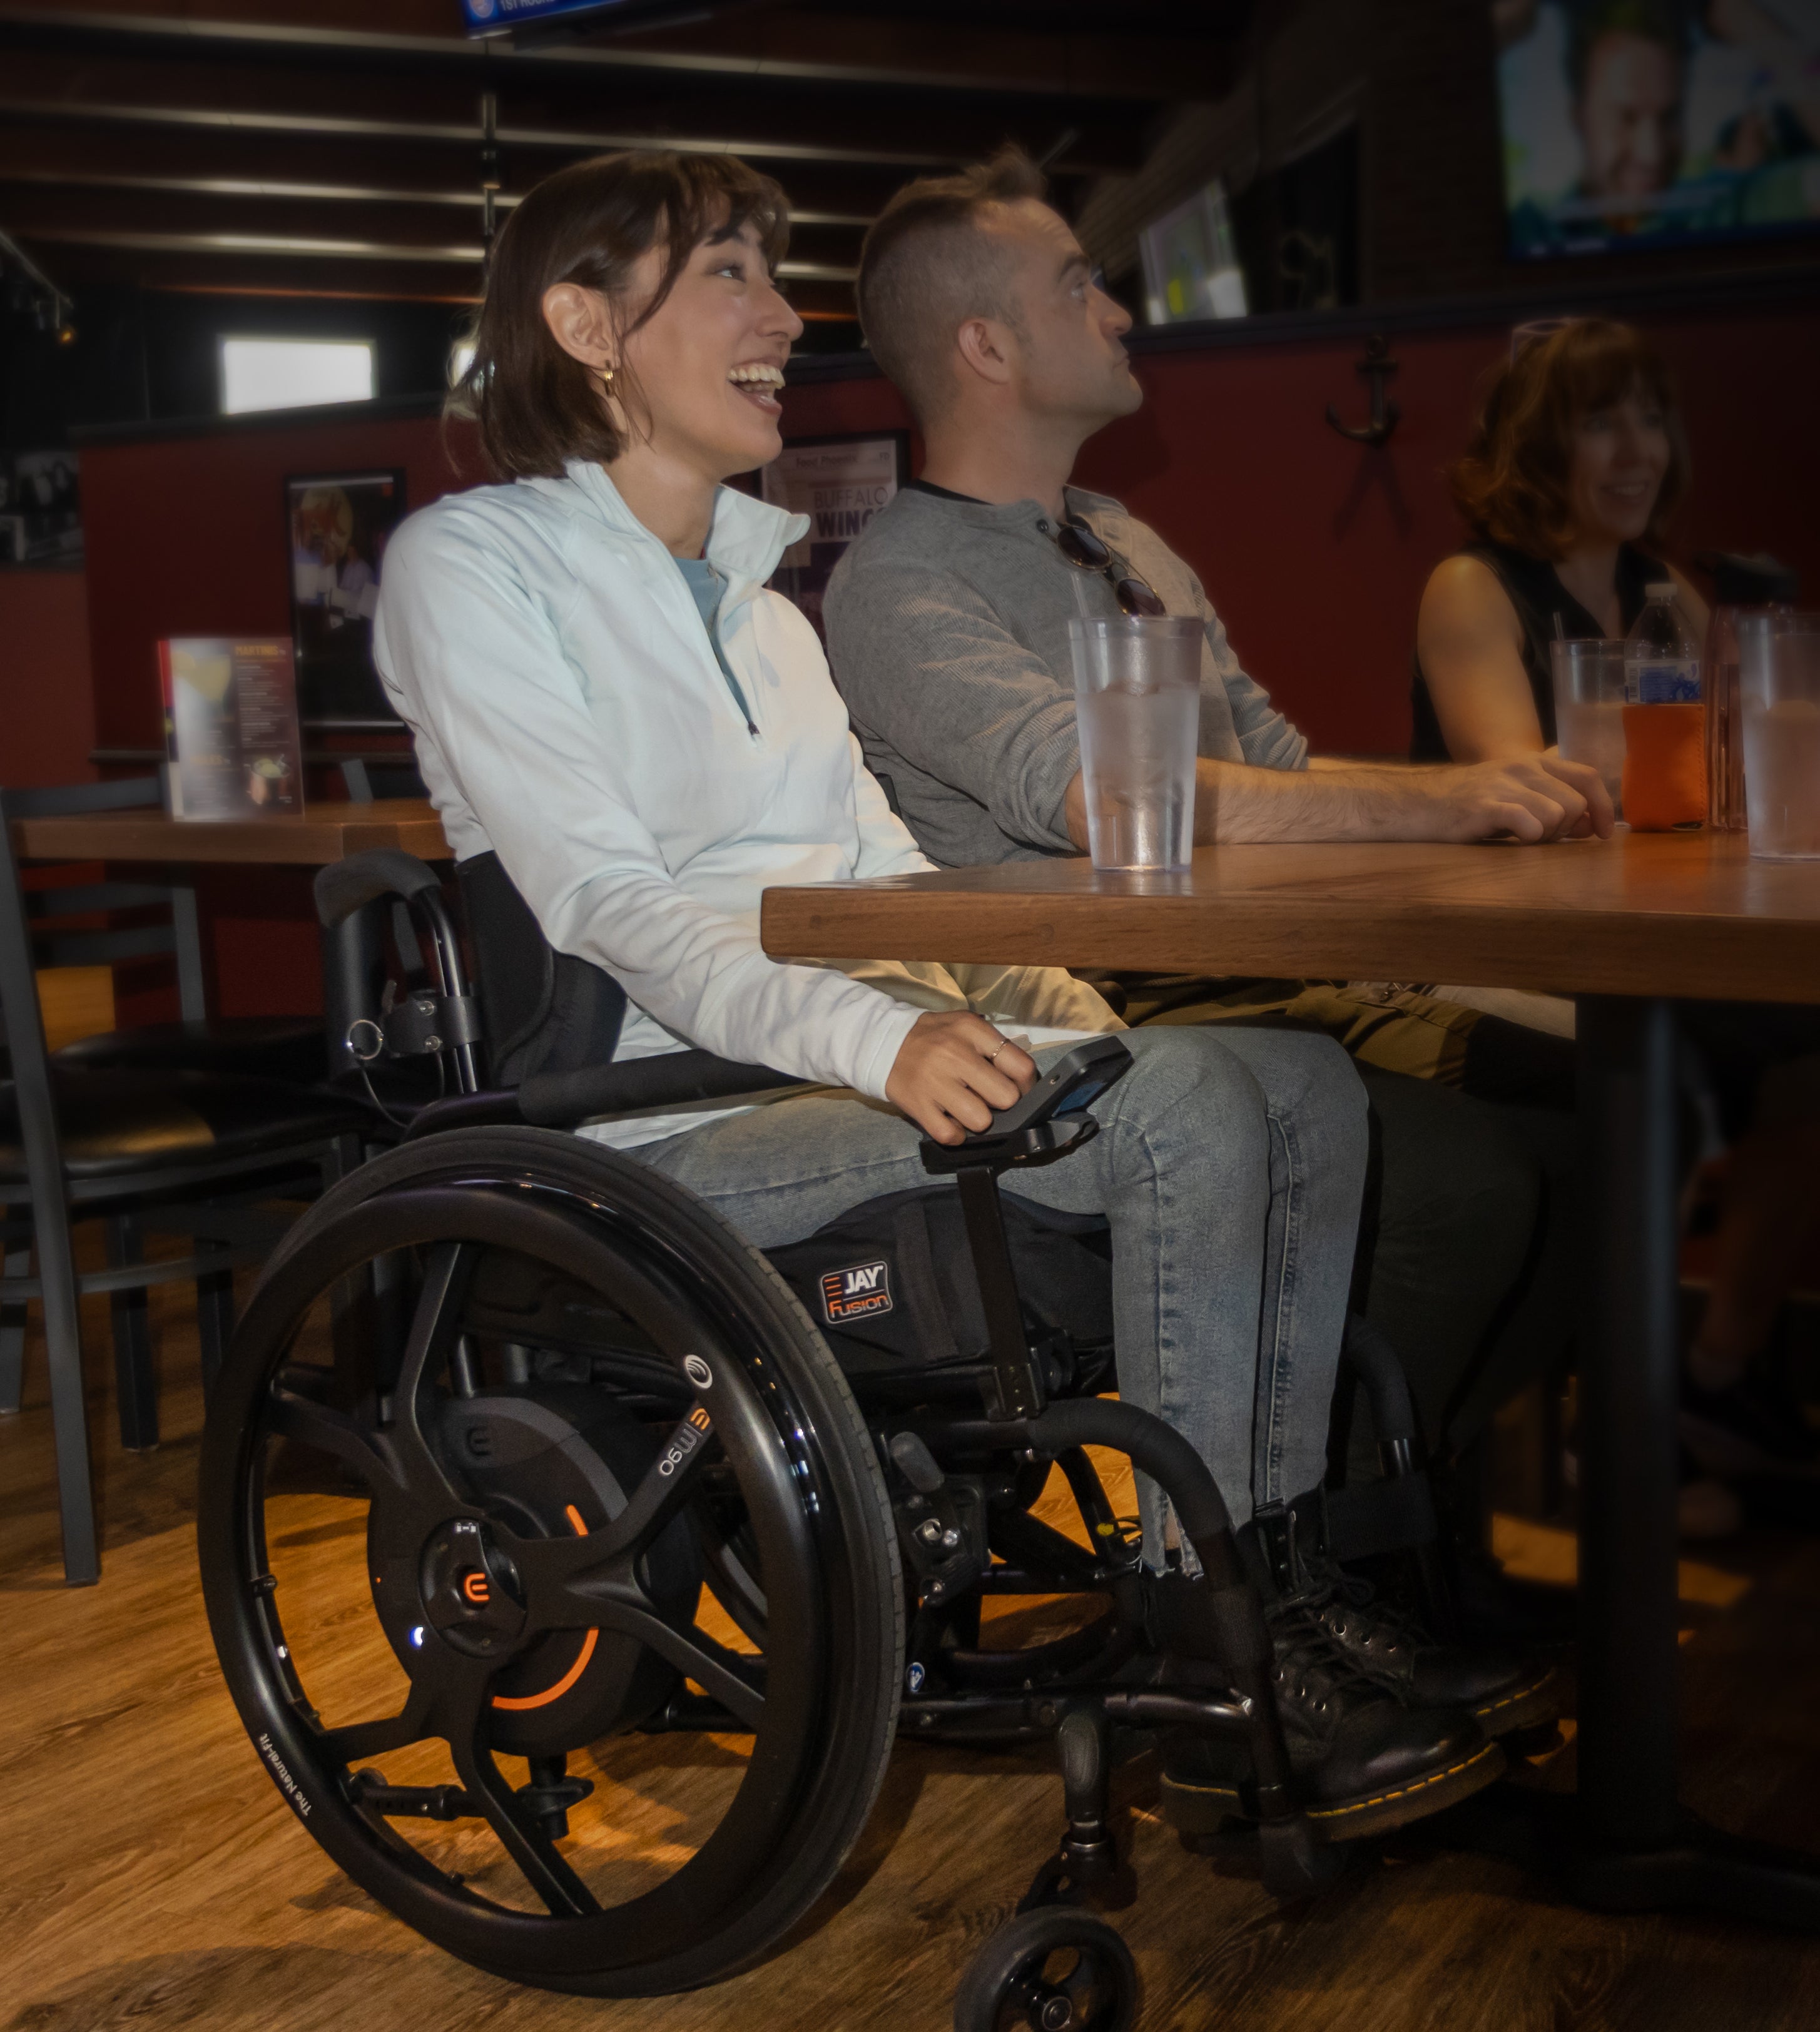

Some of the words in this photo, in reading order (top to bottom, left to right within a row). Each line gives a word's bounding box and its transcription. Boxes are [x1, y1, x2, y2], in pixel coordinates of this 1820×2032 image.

[815, 487, 888, 509] BUFFALO
[815, 507, 886, 537] WIN
[845, 1265, 884, 1294] JAY
[828, 1294, 889, 1318] Fusion
[295, 1791, 312, 1816] The
